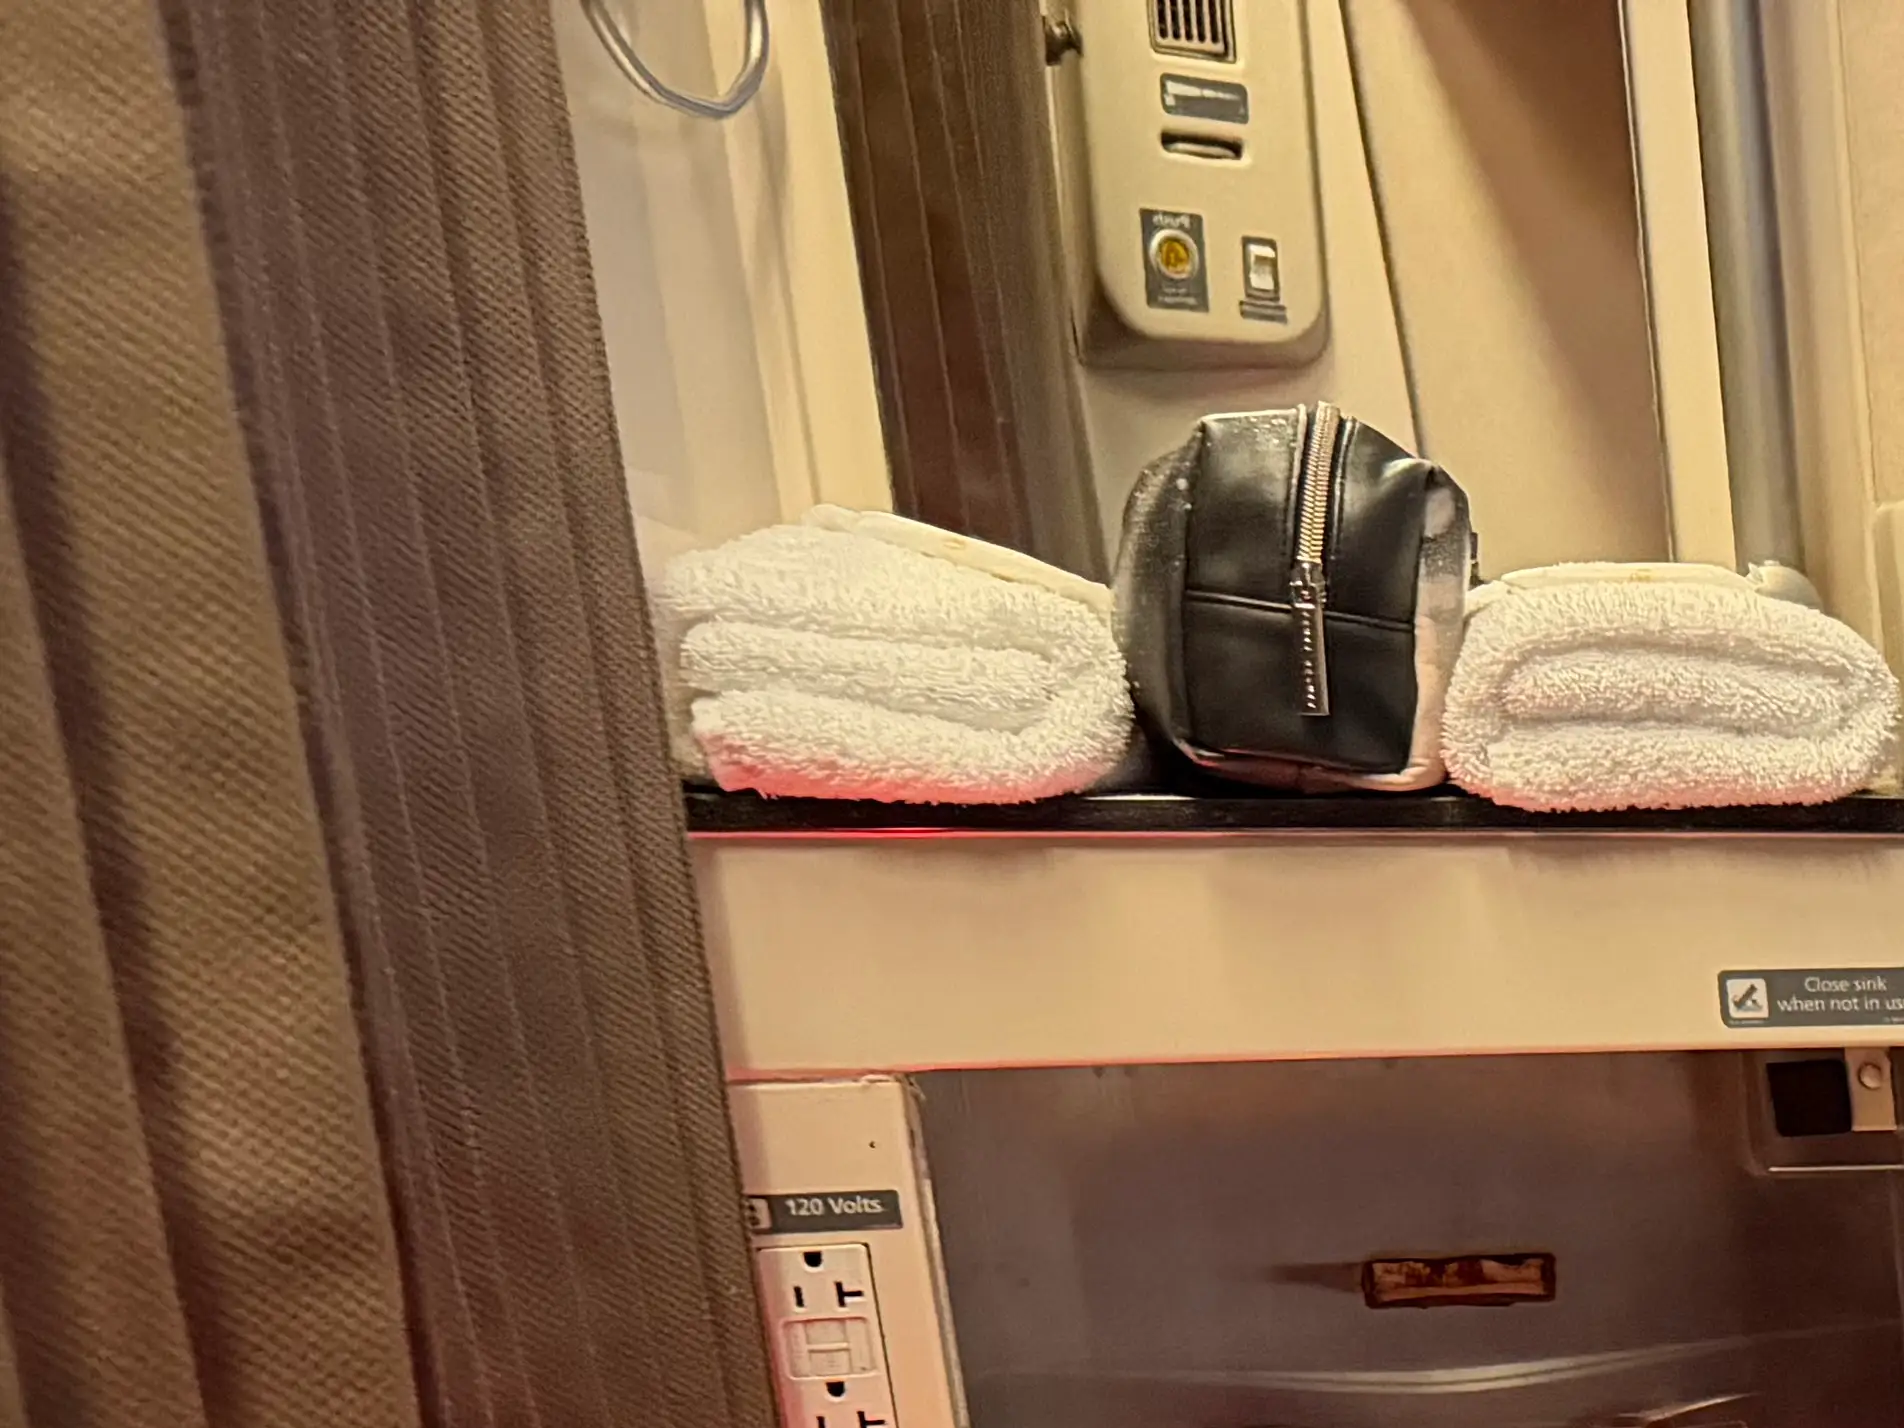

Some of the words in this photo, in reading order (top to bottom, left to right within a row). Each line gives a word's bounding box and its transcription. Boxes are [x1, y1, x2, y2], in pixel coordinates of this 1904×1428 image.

[1804, 976, 1849, 992] Close
[1854, 976, 1887, 991] sink
[1777, 996, 1825, 1012] when
[1830, 997, 1859, 1012] not
[1864, 995, 1880, 1010] in
[786, 1198, 825, 1216] 120
[828, 1194, 885, 1215] Volts
